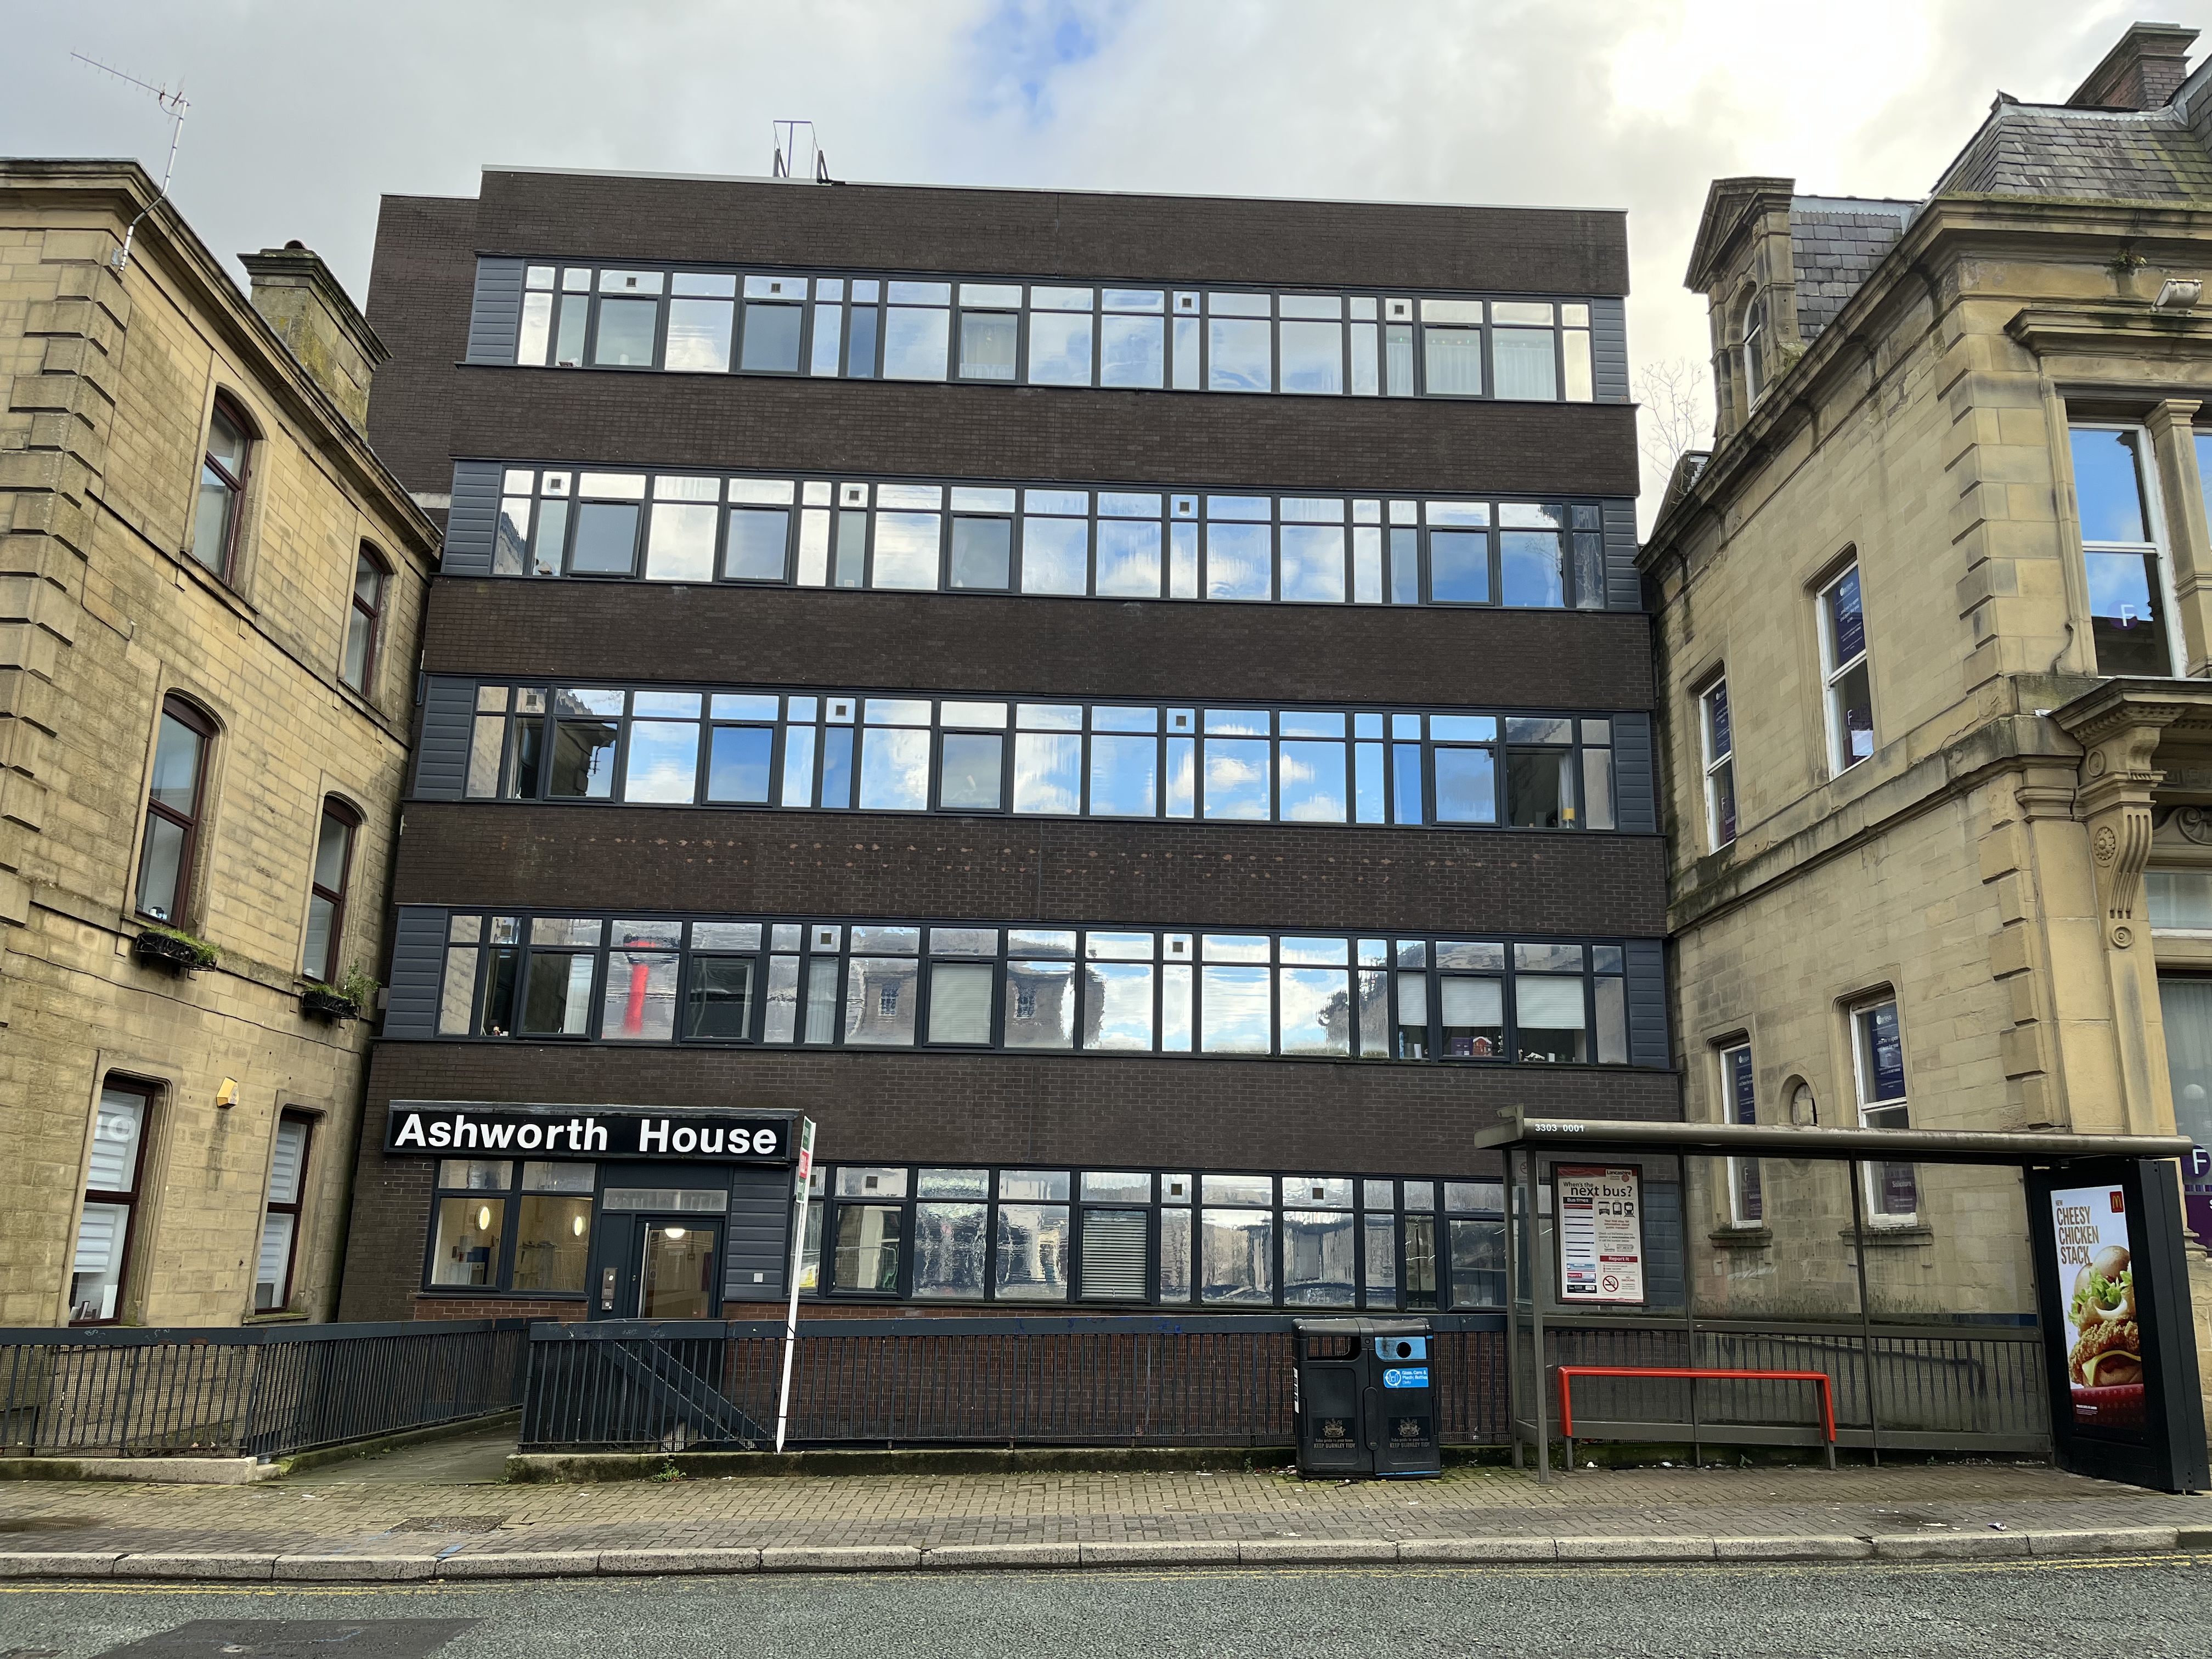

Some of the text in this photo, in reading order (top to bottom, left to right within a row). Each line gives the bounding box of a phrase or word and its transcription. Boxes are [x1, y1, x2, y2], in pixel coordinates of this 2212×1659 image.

[2120, 604, 2135, 627] F
[394, 1113, 777, 1154] Ashworth House
[1534, 1124, 1584, 1132] 3303 0001
[2192, 1149, 2208, 1174] F
[1571, 1184, 1633, 1197] next bus?
[2056, 1206, 2090, 1226] CHEESY
[2058, 1225, 2100, 1245] CHICKEN
[2060, 1245, 2091, 1265] STACK
